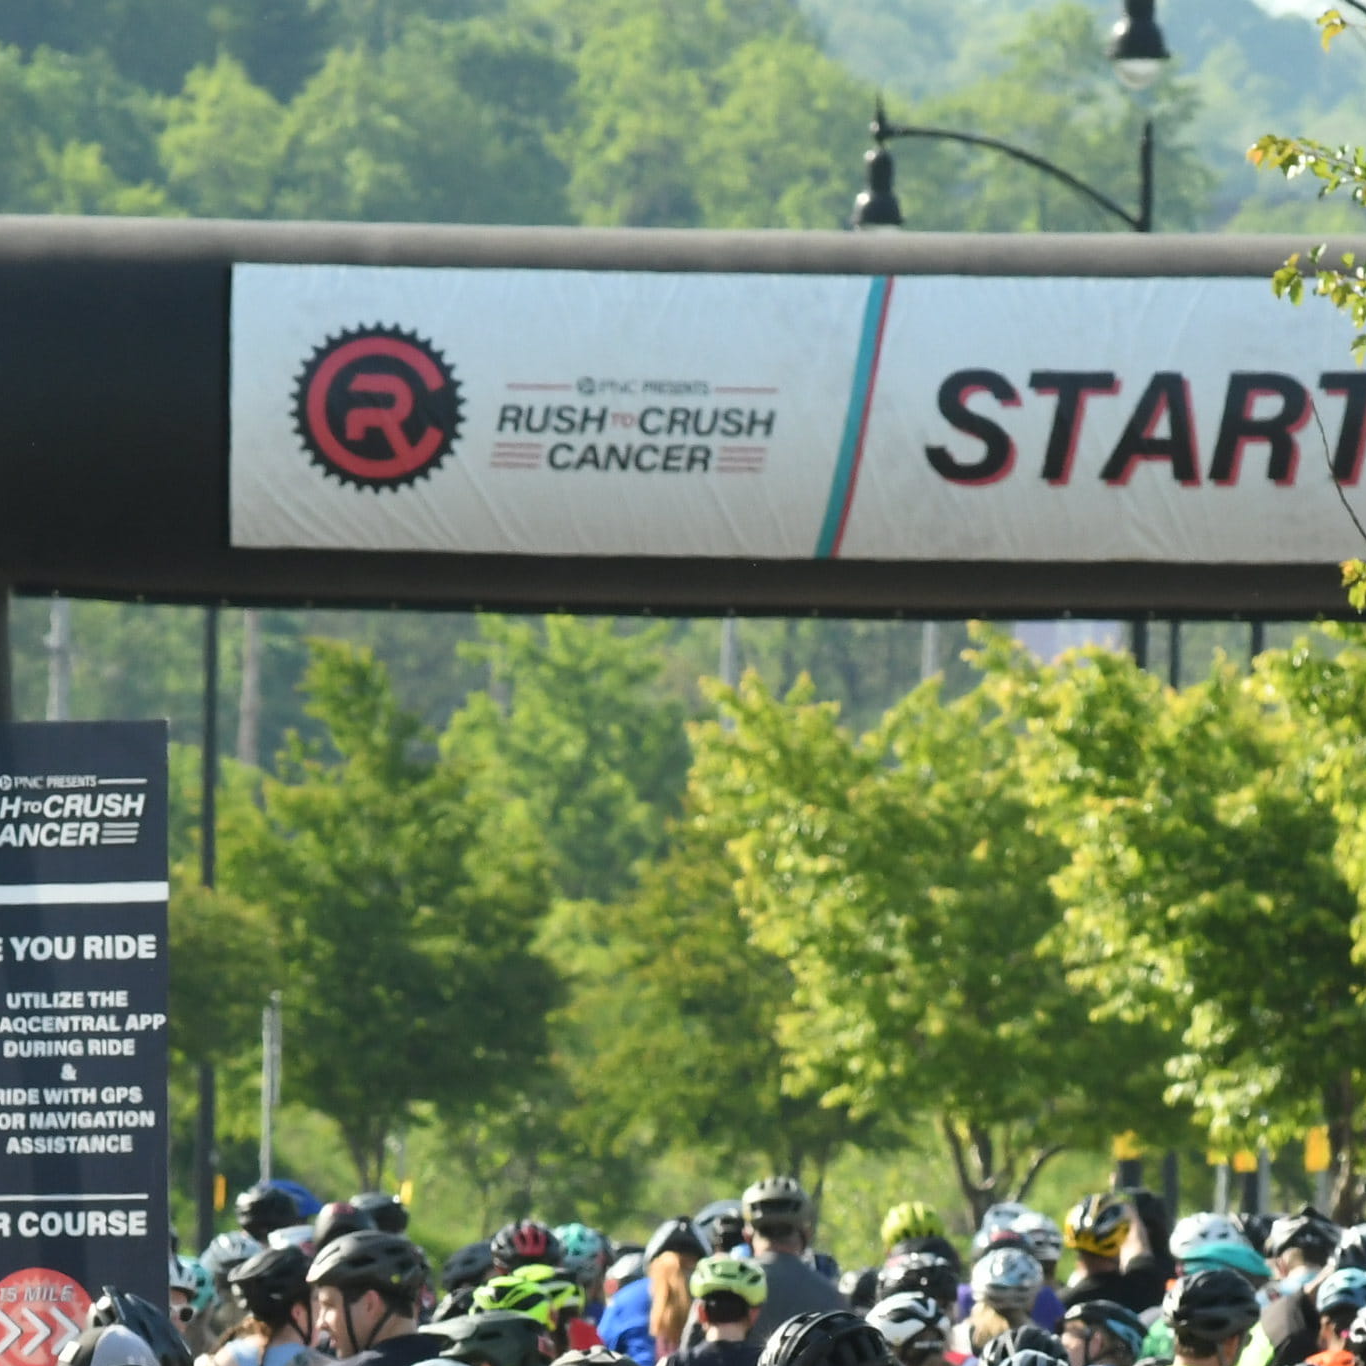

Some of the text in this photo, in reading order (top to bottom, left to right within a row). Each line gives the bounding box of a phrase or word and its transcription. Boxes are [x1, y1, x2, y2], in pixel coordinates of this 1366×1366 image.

[496, 404, 608, 436] RUSH
[638, 406, 777, 437] CRUSH
[547, 443, 713, 474] CANCER
[14, 775, 97, 789] PNC PRESENTS
[23, 802, 42, 814] TO
[43, 794, 146, 819] CRUSH
[9, 935, 76, 961] YOU
[83, 933, 158, 959] RIDE
[6, 990, 129, 1009] UTILIZE THE
[124, 1013, 167, 1031] APP
[3, 1038, 136, 1058] DURING RIDE
[60, 1063, 77, 1081] &
[42, 1087, 97, 1105] WITH
[100, 1086, 143, 1105] GPS
[28, 1110, 155, 1129] NAVIGATION
[6, 1135, 133, 1154] ASSISTANCE
[18, 1211, 148, 1236] COURSE
[23, 1286, 75, 1302] MILE
